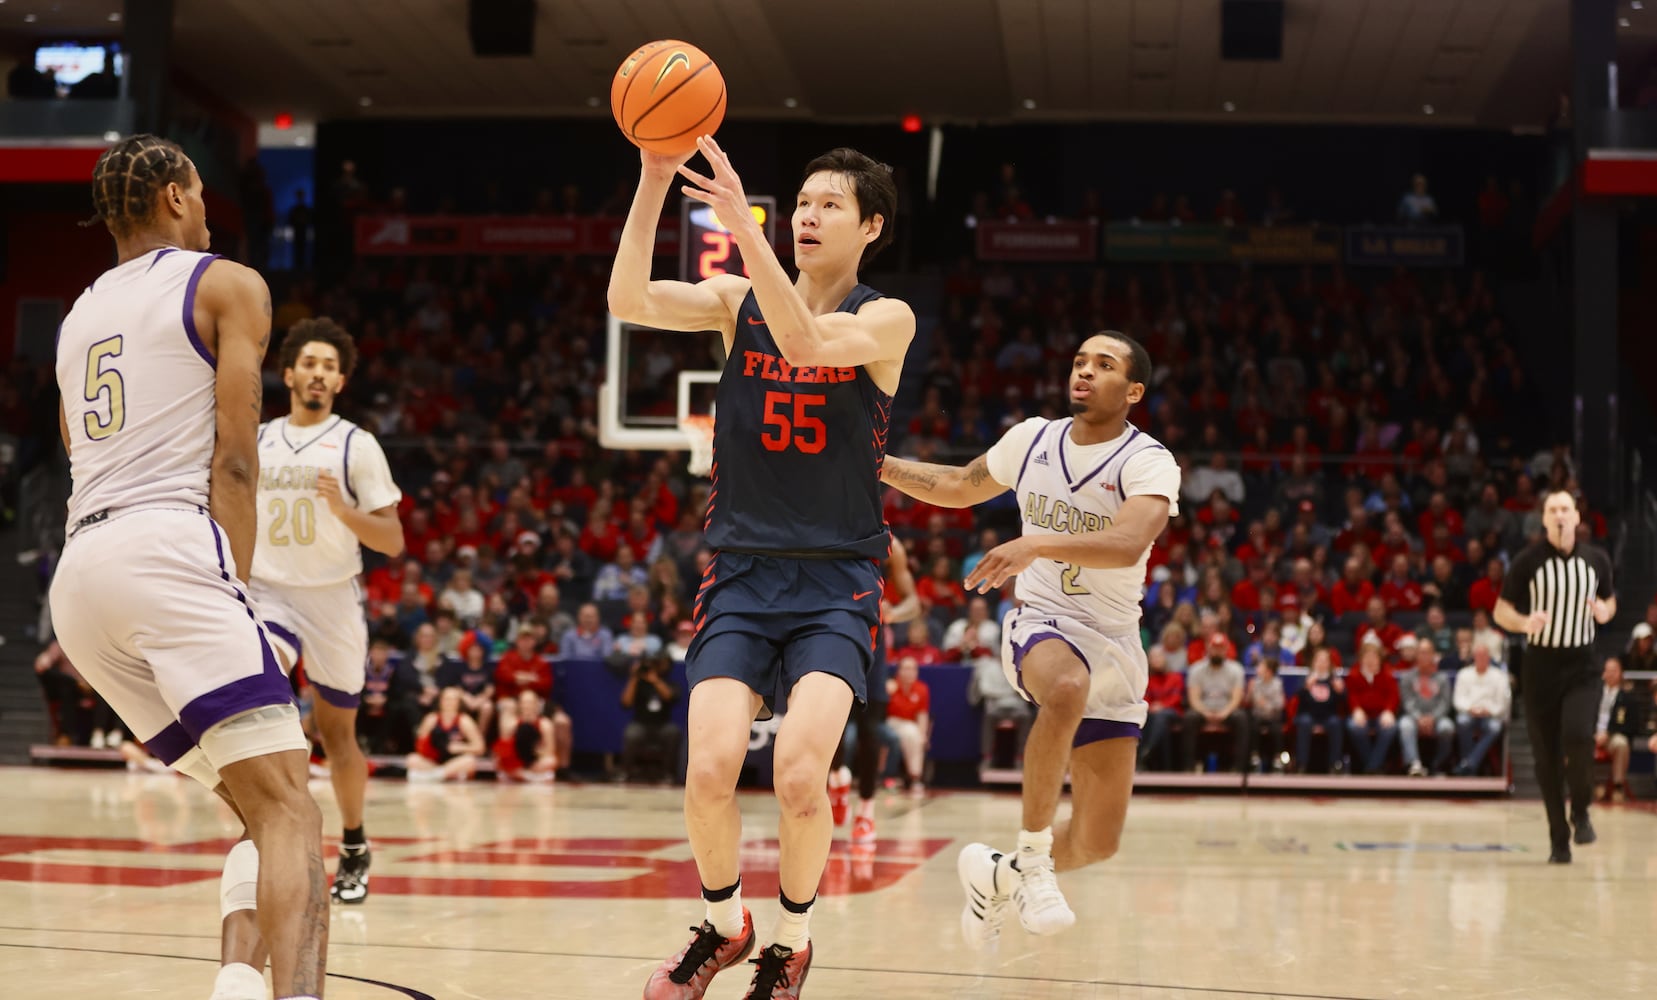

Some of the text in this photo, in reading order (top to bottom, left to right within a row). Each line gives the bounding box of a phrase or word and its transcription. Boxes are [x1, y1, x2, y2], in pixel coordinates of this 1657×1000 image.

[83, 333, 126, 441] 5
[761, 390, 827, 455] 55
[268, 497, 316, 547] 20
